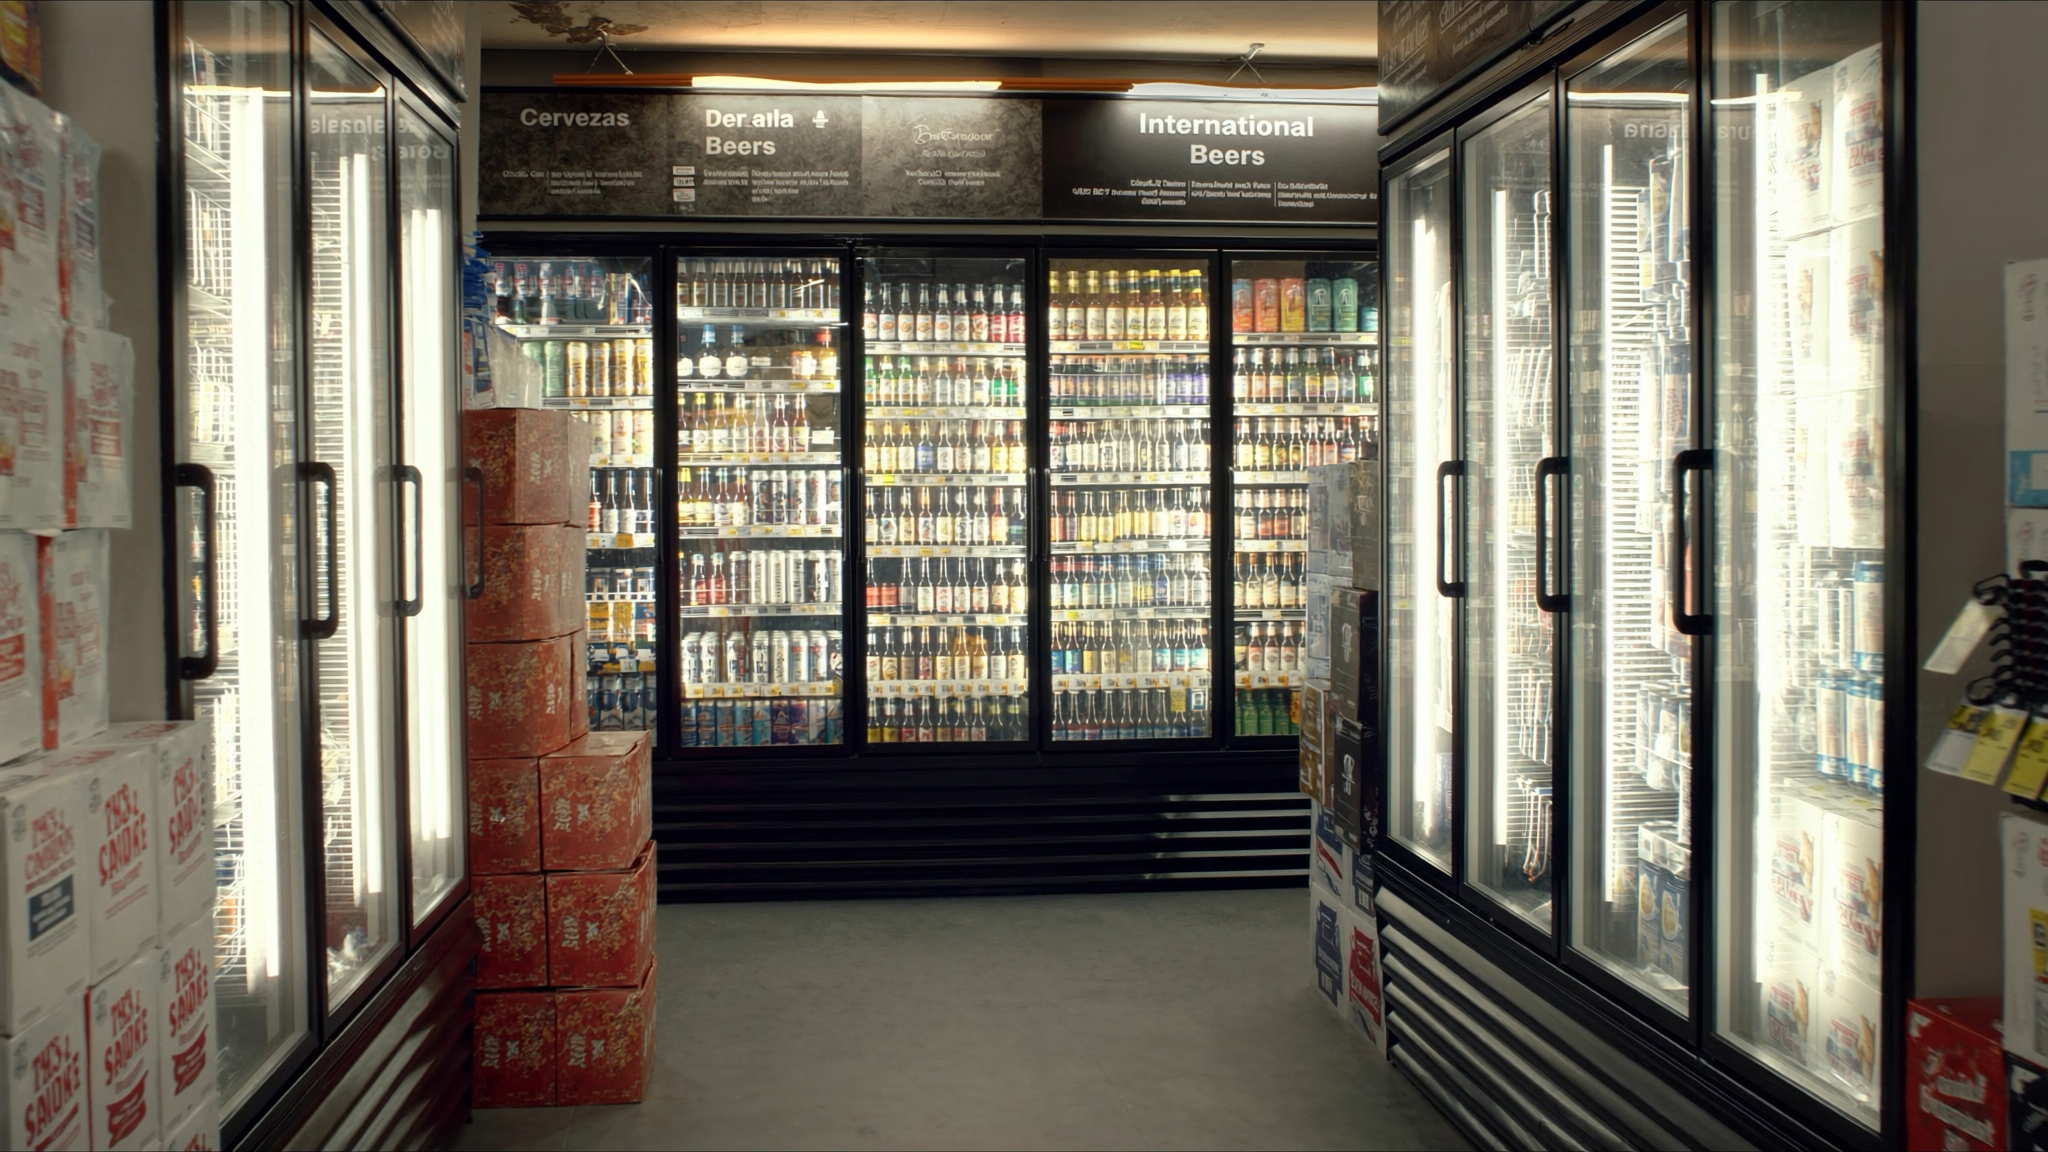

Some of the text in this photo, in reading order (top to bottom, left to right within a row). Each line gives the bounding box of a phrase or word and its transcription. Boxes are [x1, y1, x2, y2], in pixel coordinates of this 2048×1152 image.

[520, 108, 630, 127] Cervezas
[706, 109, 748, 129] Der
[1139, 112, 1314, 137] International
[706, 136, 776, 155] Beers
[1190, 144, 1266, 166] Beers
